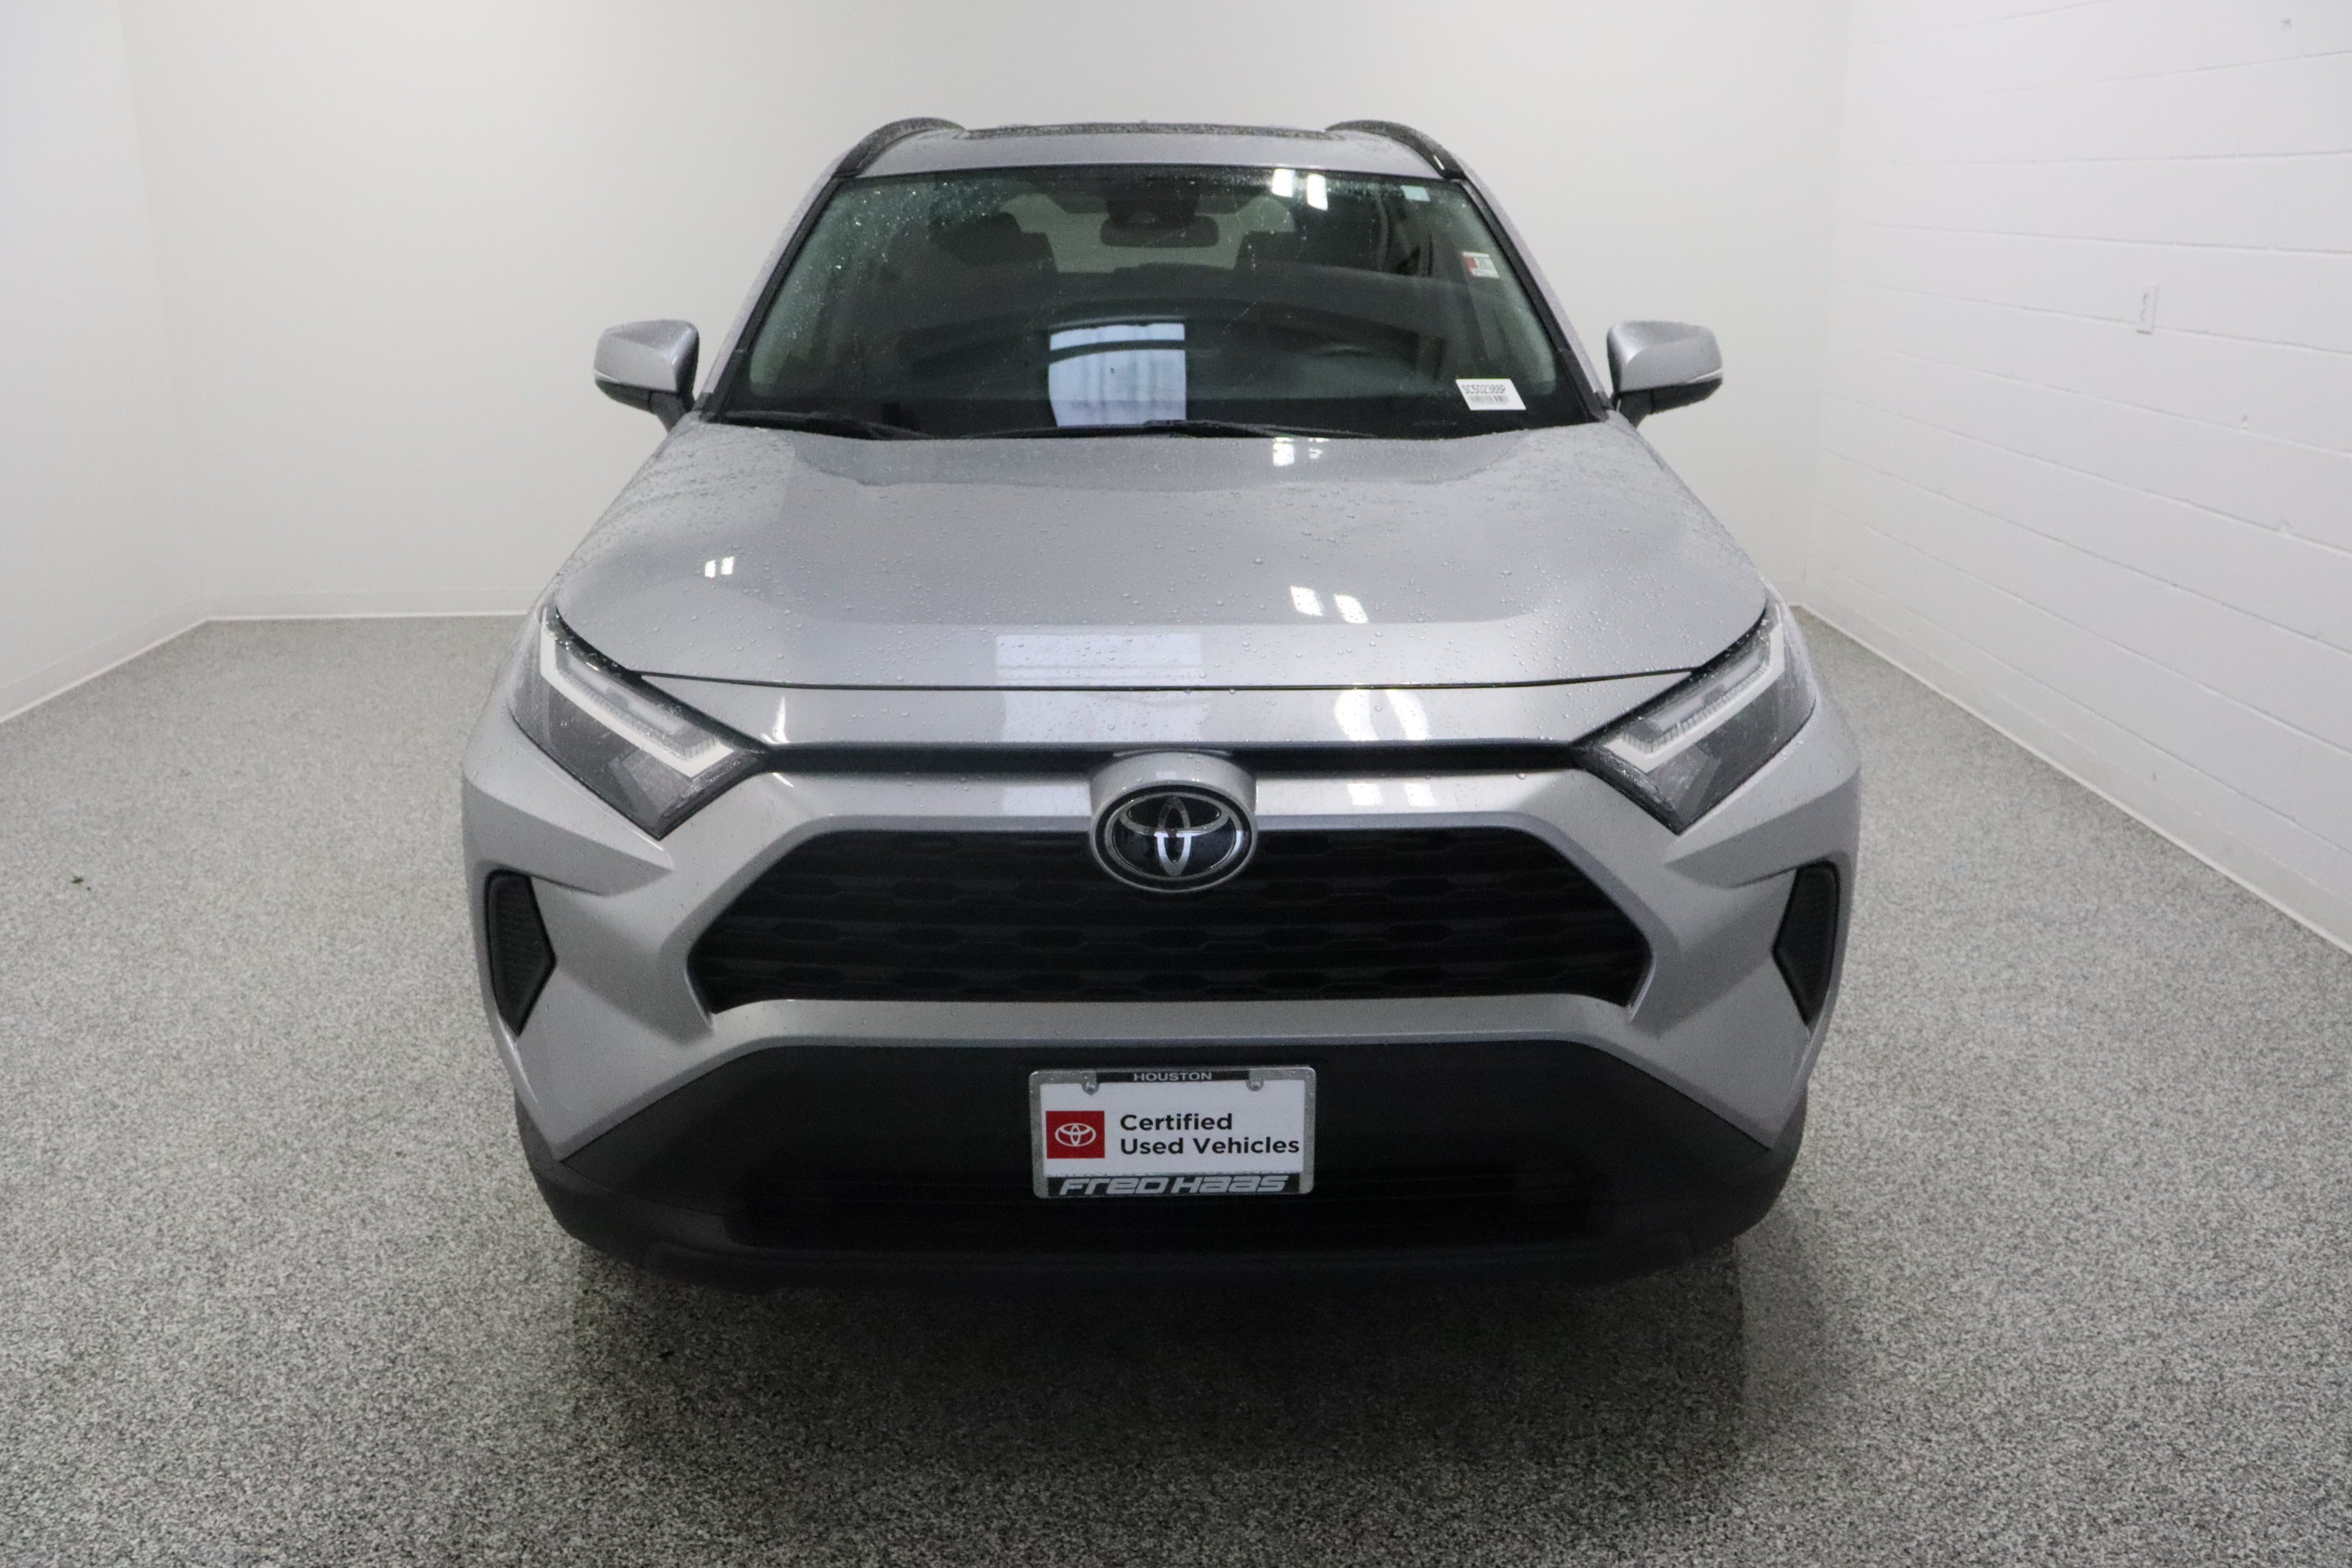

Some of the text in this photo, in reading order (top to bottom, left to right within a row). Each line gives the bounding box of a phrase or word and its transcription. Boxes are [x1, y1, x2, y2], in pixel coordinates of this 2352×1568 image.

[1133, 1072, 1213, 1082] HOUSTON
[1120, 1113, 1233, 1131] Certified
[1121, 1136, 1299, 1155] Used Vehicles
